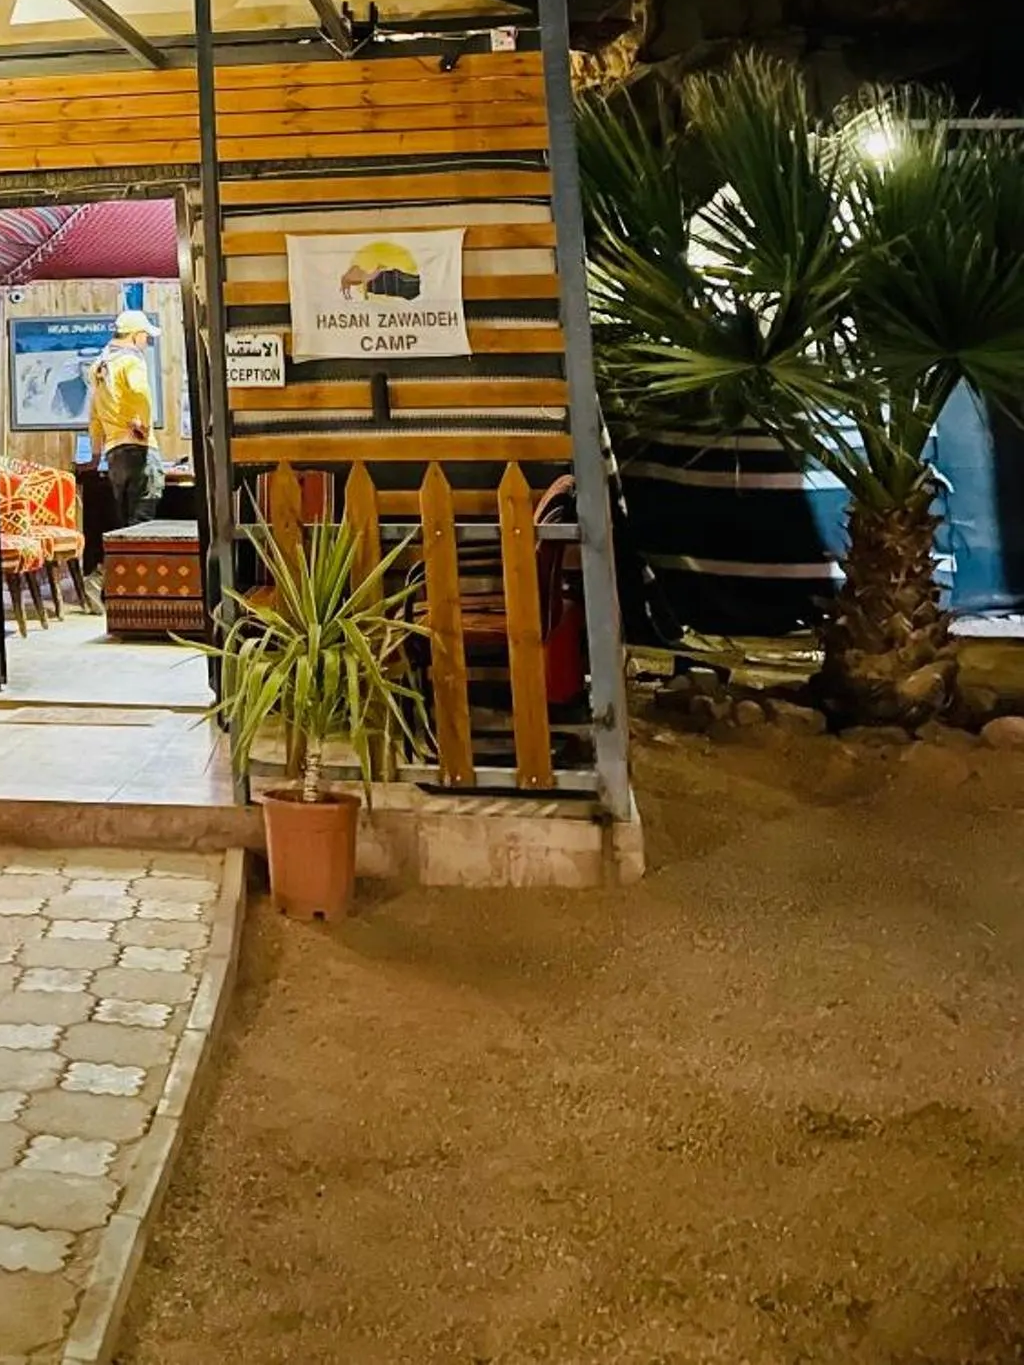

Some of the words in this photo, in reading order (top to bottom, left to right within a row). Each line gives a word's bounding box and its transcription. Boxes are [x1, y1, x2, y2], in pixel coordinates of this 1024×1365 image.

[316, 313, 370, 330] HASAN
[377, 311, 458, 328] ZAWAIDEH
[226, 340, 279, 363] الاستقبا
[360, 334, 418, 352] CAMP
[225, 367, 281, 382] ECEPTION
